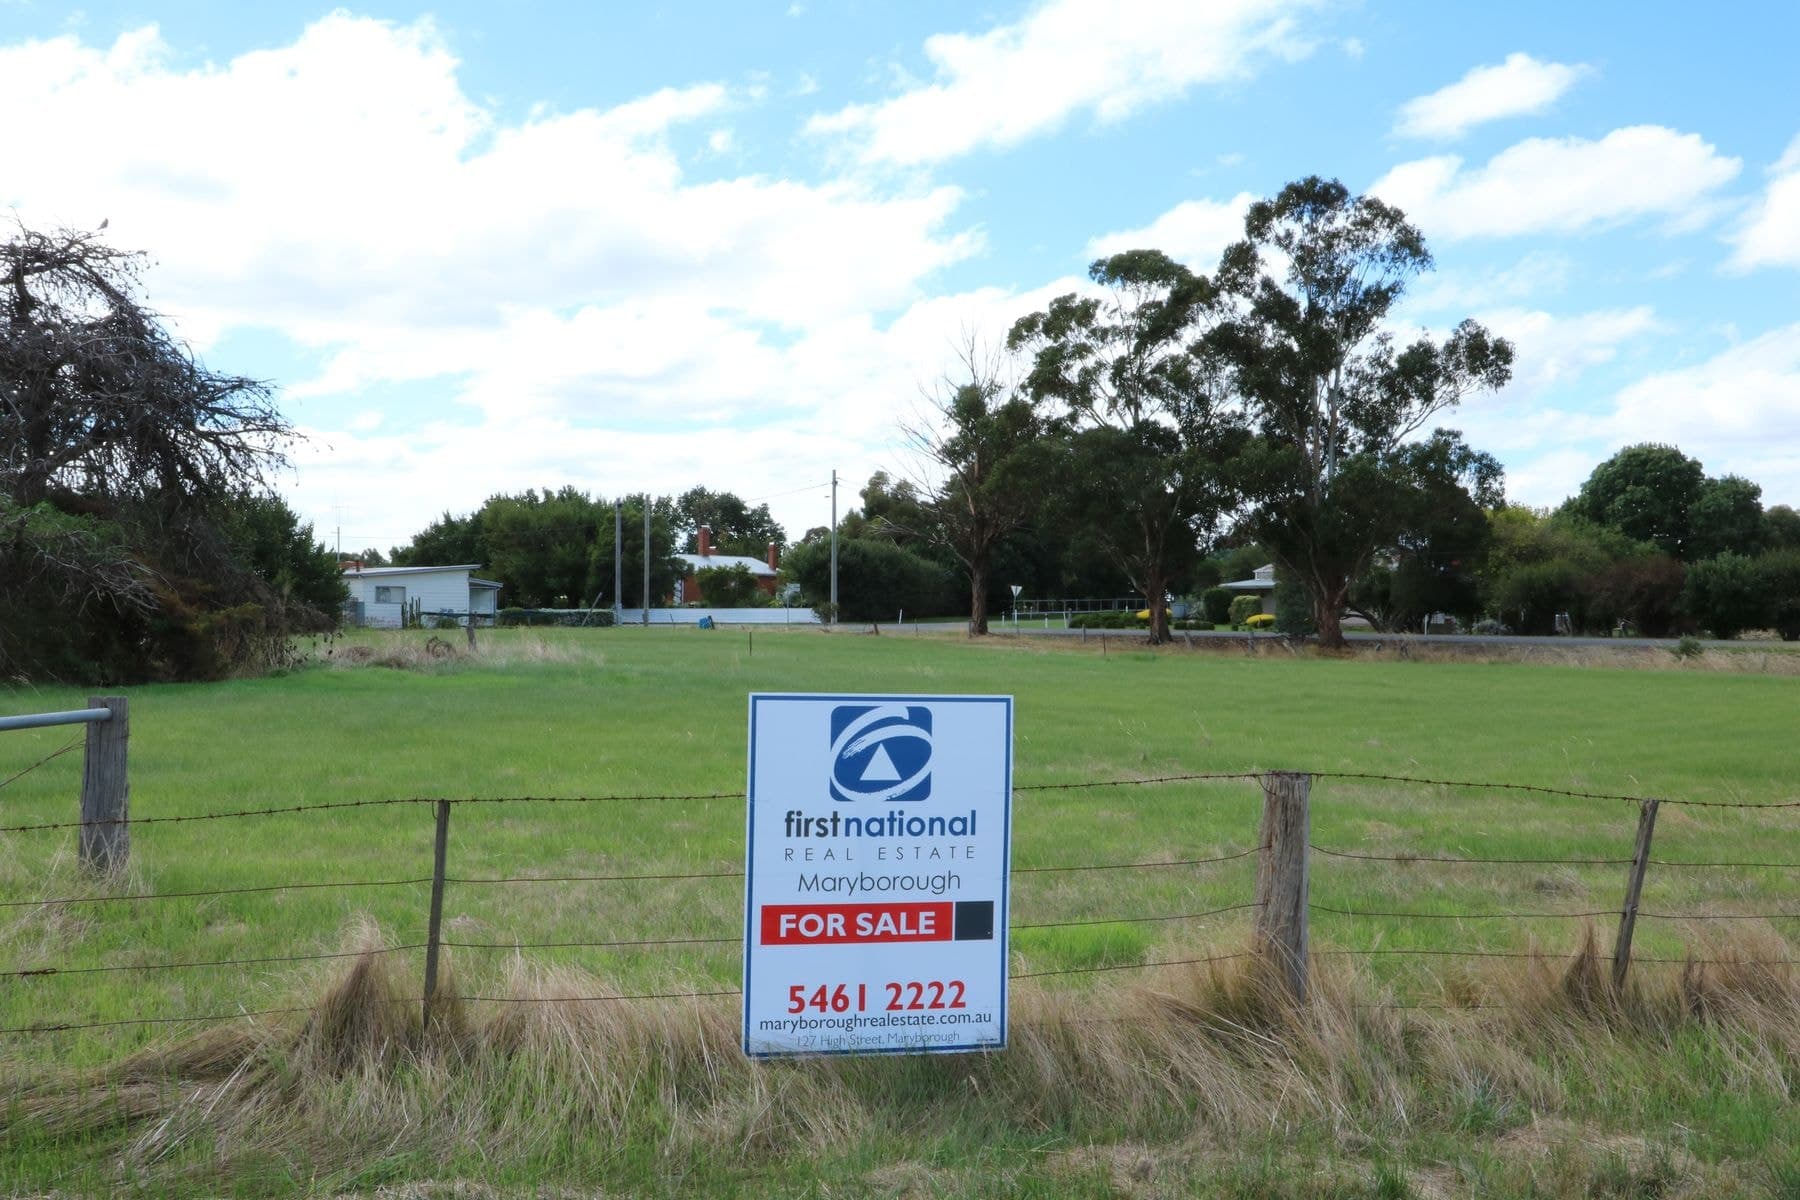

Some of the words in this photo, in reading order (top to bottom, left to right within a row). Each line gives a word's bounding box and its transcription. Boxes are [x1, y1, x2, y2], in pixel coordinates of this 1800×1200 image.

[784, 847, 854, 861] REAL
[878, 845, 975, 860] ESTATE
[798, 871, 961, 896] Maryborough
[779, 912, 846, 937] FOR
[855, 911, 936, 936] SALE
[788, 984, 866, 1013] 5461
[885, 980, 966, 1011] 2222
[759, 1012, 992, 1033] maryboroughrealestate.com.au
[797, 1035, 817, 1048] 127
[820, 1034, 846, 1049] High
[887, 1031, 960, 1046] Maryborough
